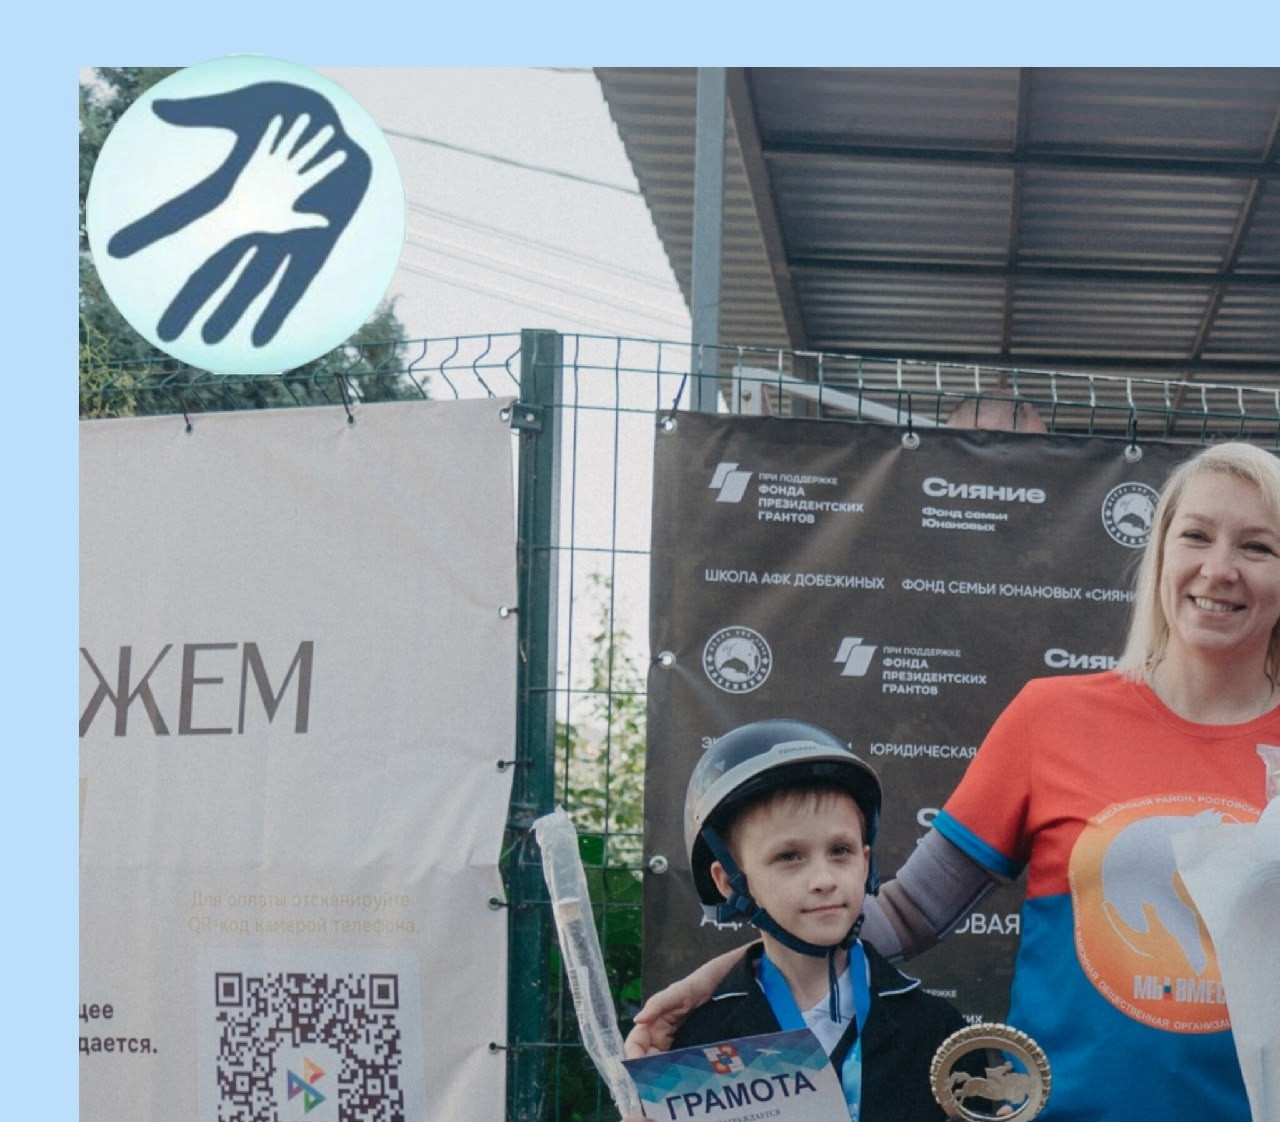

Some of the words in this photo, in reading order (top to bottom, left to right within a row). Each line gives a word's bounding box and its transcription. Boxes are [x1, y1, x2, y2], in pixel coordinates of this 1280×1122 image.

[758, 472, 777, 481] ПРИ
[781, 474, 838, 486] ПОДДЕРЖКЕ
[758, 484, 805, 497] ФОНДА
[921, 477, 1046, 504] Сияние
[758, 497, 864, 513] ПРЕЗИДЕНТСКИХ
[758, 510, 815, 524] ГРАНТОВ
[921, 506, 963, 520] Фонд
[964, 510, 1008, 521] семьи
[921, 518, 996, 532] Юнановых
[705, 568, 758, 584] ШКОЛА
[761, 572, 791, 585] АФК
[794, 573, 885, 590] ДОБЕЖИНЫХ
[901, 578, 945, 594] ФОНД
[948, 581, 996, 595] СЕМЬИ
[999, 584, 1082, 600] ЮНАНОВЫХ
[883, 646, 901, 655] ПРИ
[903, 648, 961, 658] ПОДДЕРЖКЕ
[882, 657, 929, 670] ФОНДА
[882, 670, 987, 685] ПРЕЗИДЕНТСКИХ
[882, 683, 939, 695] ГРАНТОВ
[870, 743, 977, 759] ЮРИДИЧЕСКАЯ
[665, 1070, 817, 1121] ГРАМОТА
